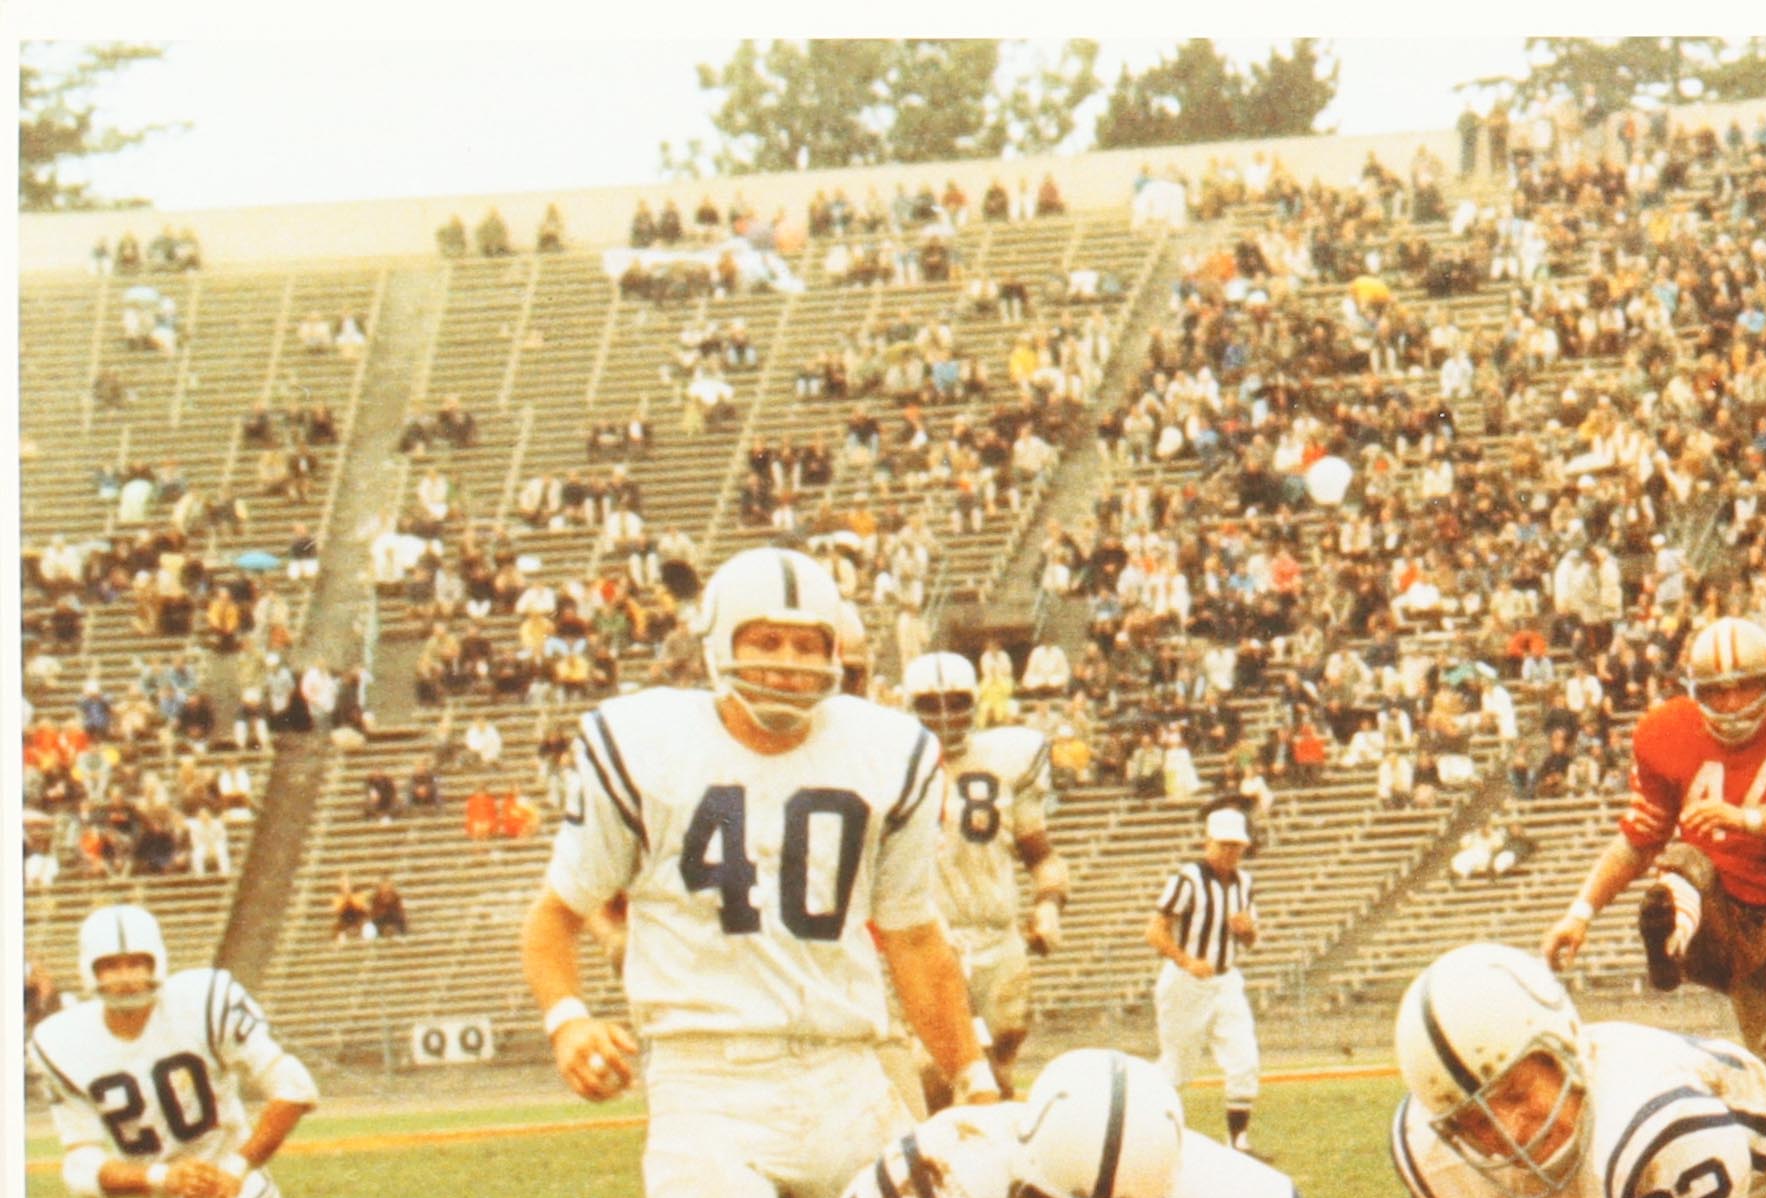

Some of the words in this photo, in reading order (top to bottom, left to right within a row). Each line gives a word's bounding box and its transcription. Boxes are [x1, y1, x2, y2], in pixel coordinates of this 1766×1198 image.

[957, 771, 998, 843] 8
[679, 785, 870, 941] 40
[88, 1053, 220, 1155] 20
